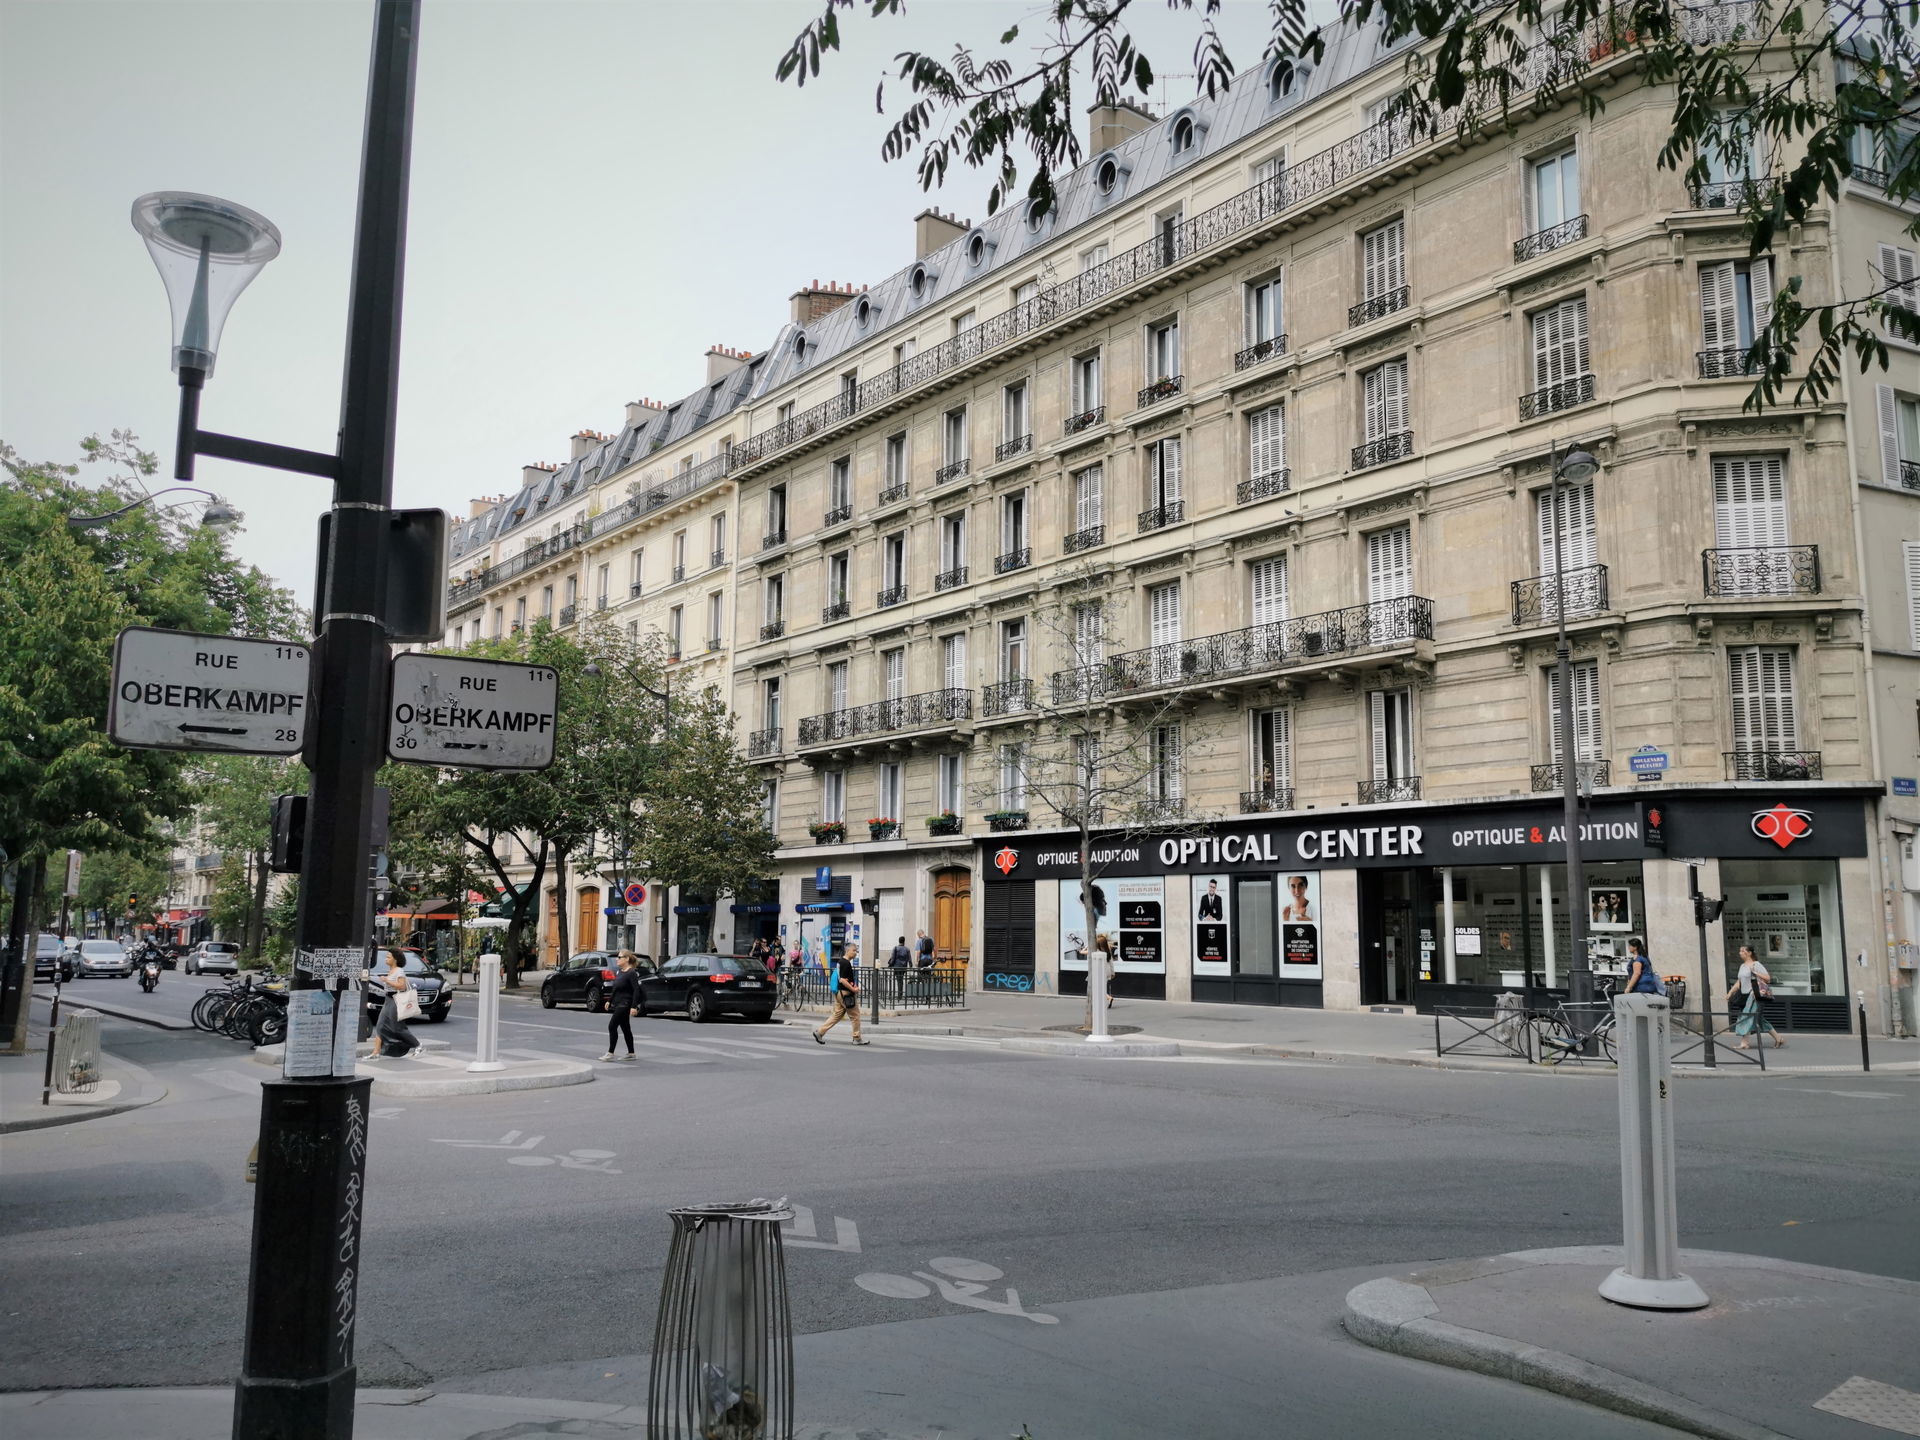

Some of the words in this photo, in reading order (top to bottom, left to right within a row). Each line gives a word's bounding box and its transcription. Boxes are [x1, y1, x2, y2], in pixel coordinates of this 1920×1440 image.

[195, 652, 239, 669] RUE
[460, 676, 497, 692] RUE
[121, 681, 304, 715] OBERKAMPF
[395, 703, 553, 733] OBERKAMPF
[274, 729, 297, 742] 28
[396, 737, 417, 749] 30
[1159, 833, 1279, 865] OPTICAL
[1296, 825, 1423, 860] CENTER
[1452, 828, 1525, 847] OPTIQUE
[1529, 826, 1544, 844] &
[1037, 851, 1079, 865] OPTIQUE
